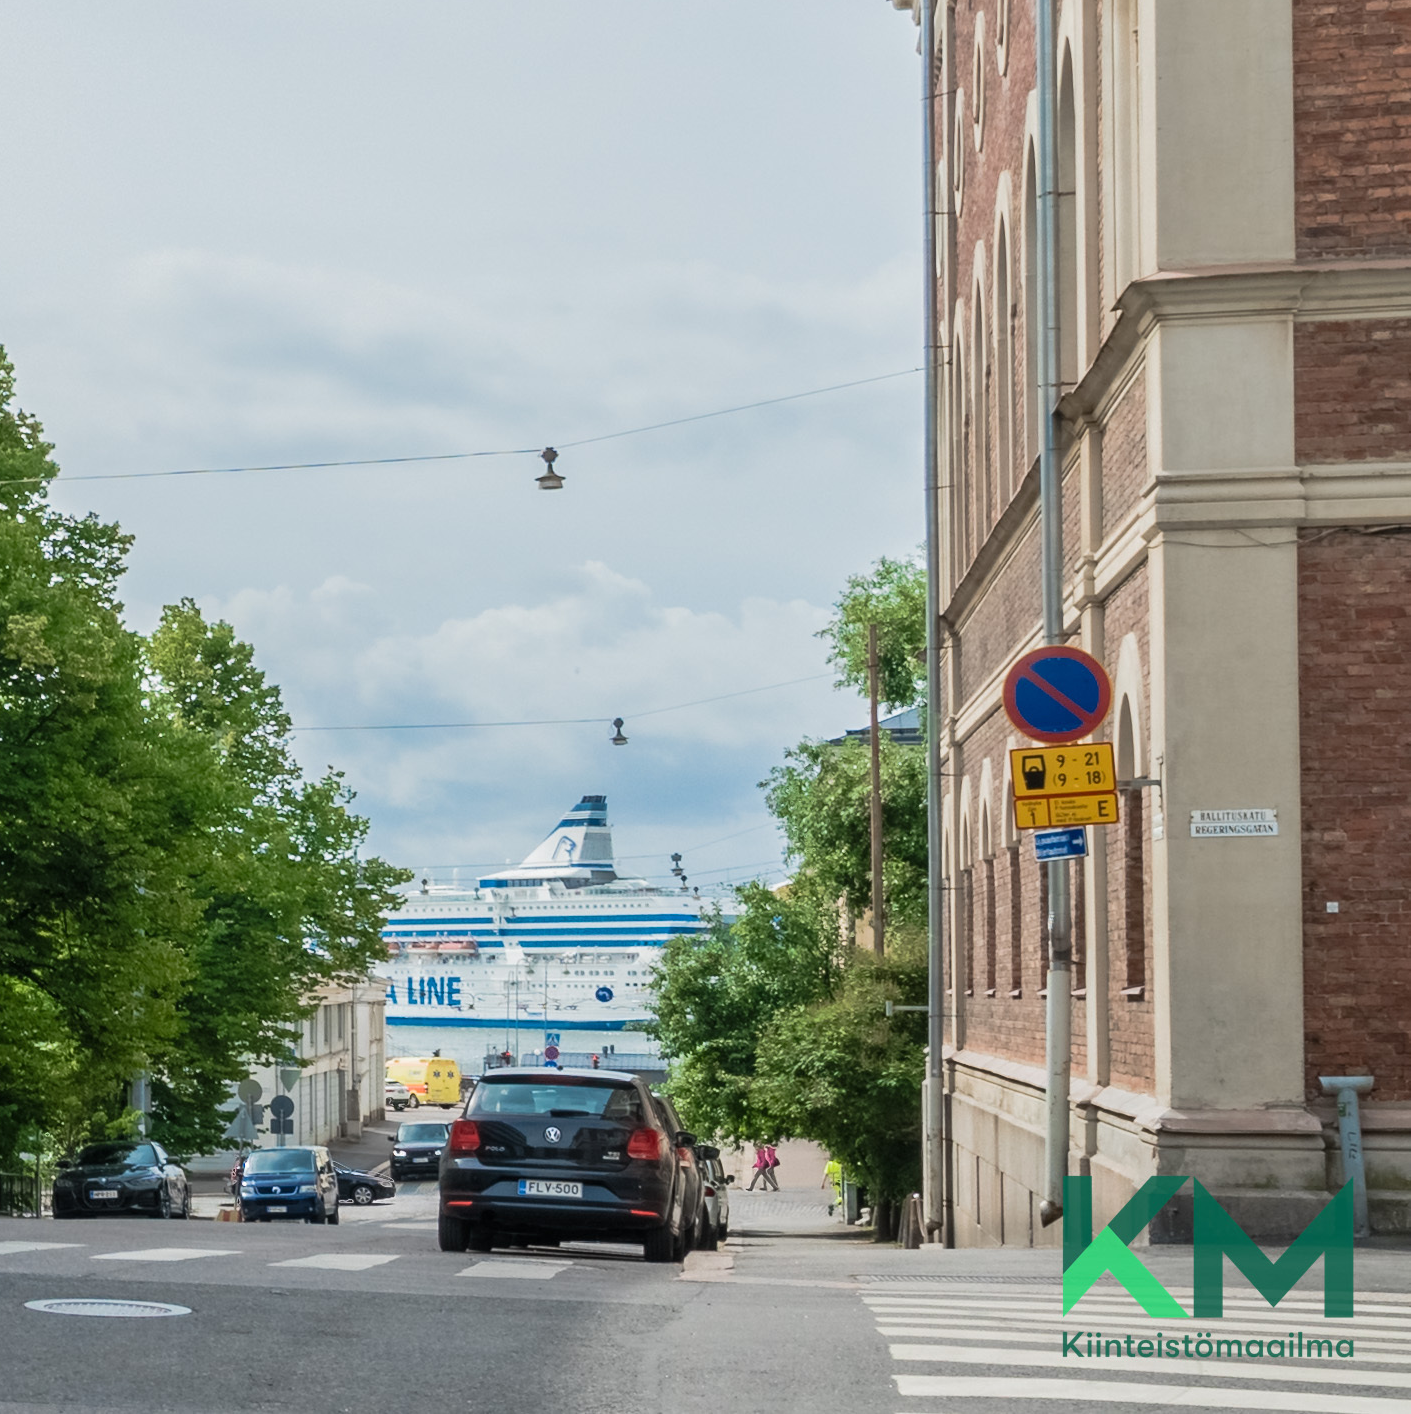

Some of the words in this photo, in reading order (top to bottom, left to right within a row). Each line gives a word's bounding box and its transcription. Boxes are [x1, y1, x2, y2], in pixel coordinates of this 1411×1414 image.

[1056, 754, 1065, 768] 9
[1084, 751, 1100, 766] 21
[1052, 773, 1067, 787] (9
[1086, 770, 1107, 785] 18)
[1097, 800, 1110, 818] E
[1200, 811, 1266, 821] HALLITUSKATU
[1029, 811, 1036, 826] 1
[1195, 824, 1274, 835] REGERINGSGATAN
[408, 976, 461, 1005] LINE
